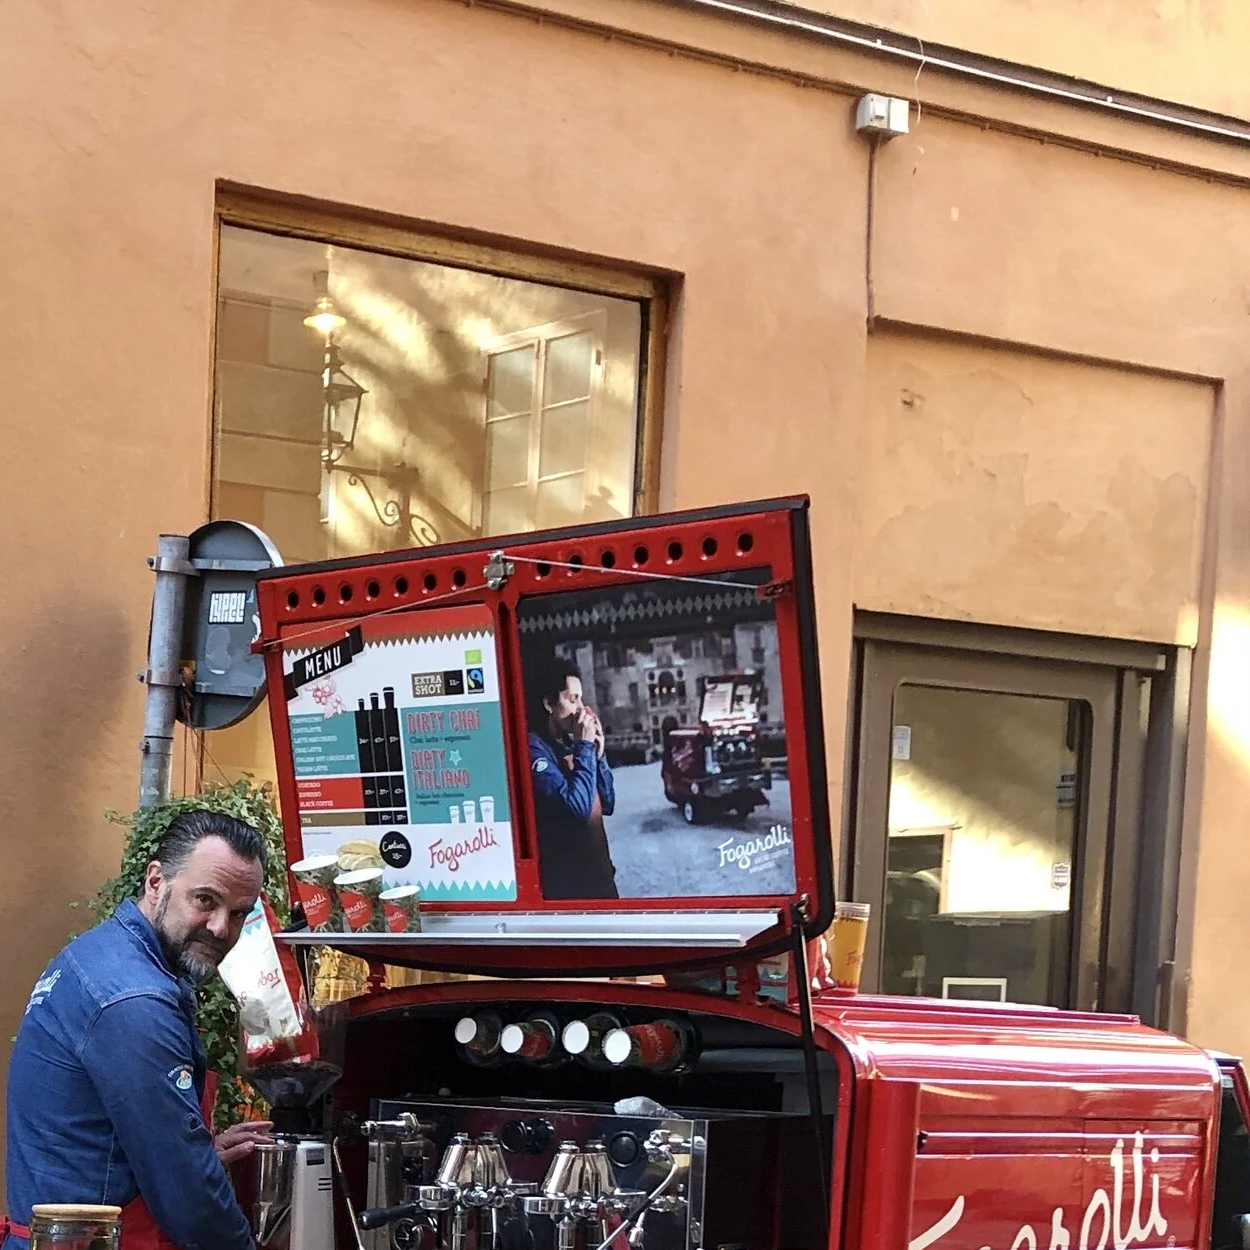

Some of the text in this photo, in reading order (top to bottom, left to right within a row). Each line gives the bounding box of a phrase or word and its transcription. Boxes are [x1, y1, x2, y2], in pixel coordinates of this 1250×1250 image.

[305, 646, 341, 680] MENU
[414, 675, 442, 686] EXTRA
[415, 684, 442, 695] SHOT
[407, 711, 444, 734] DIRTY
[411, 749, 446, 770] DIRTY
[427, 825, 498, 872] Fogarolli
[717, 824, 792, 870] Fogarolli
